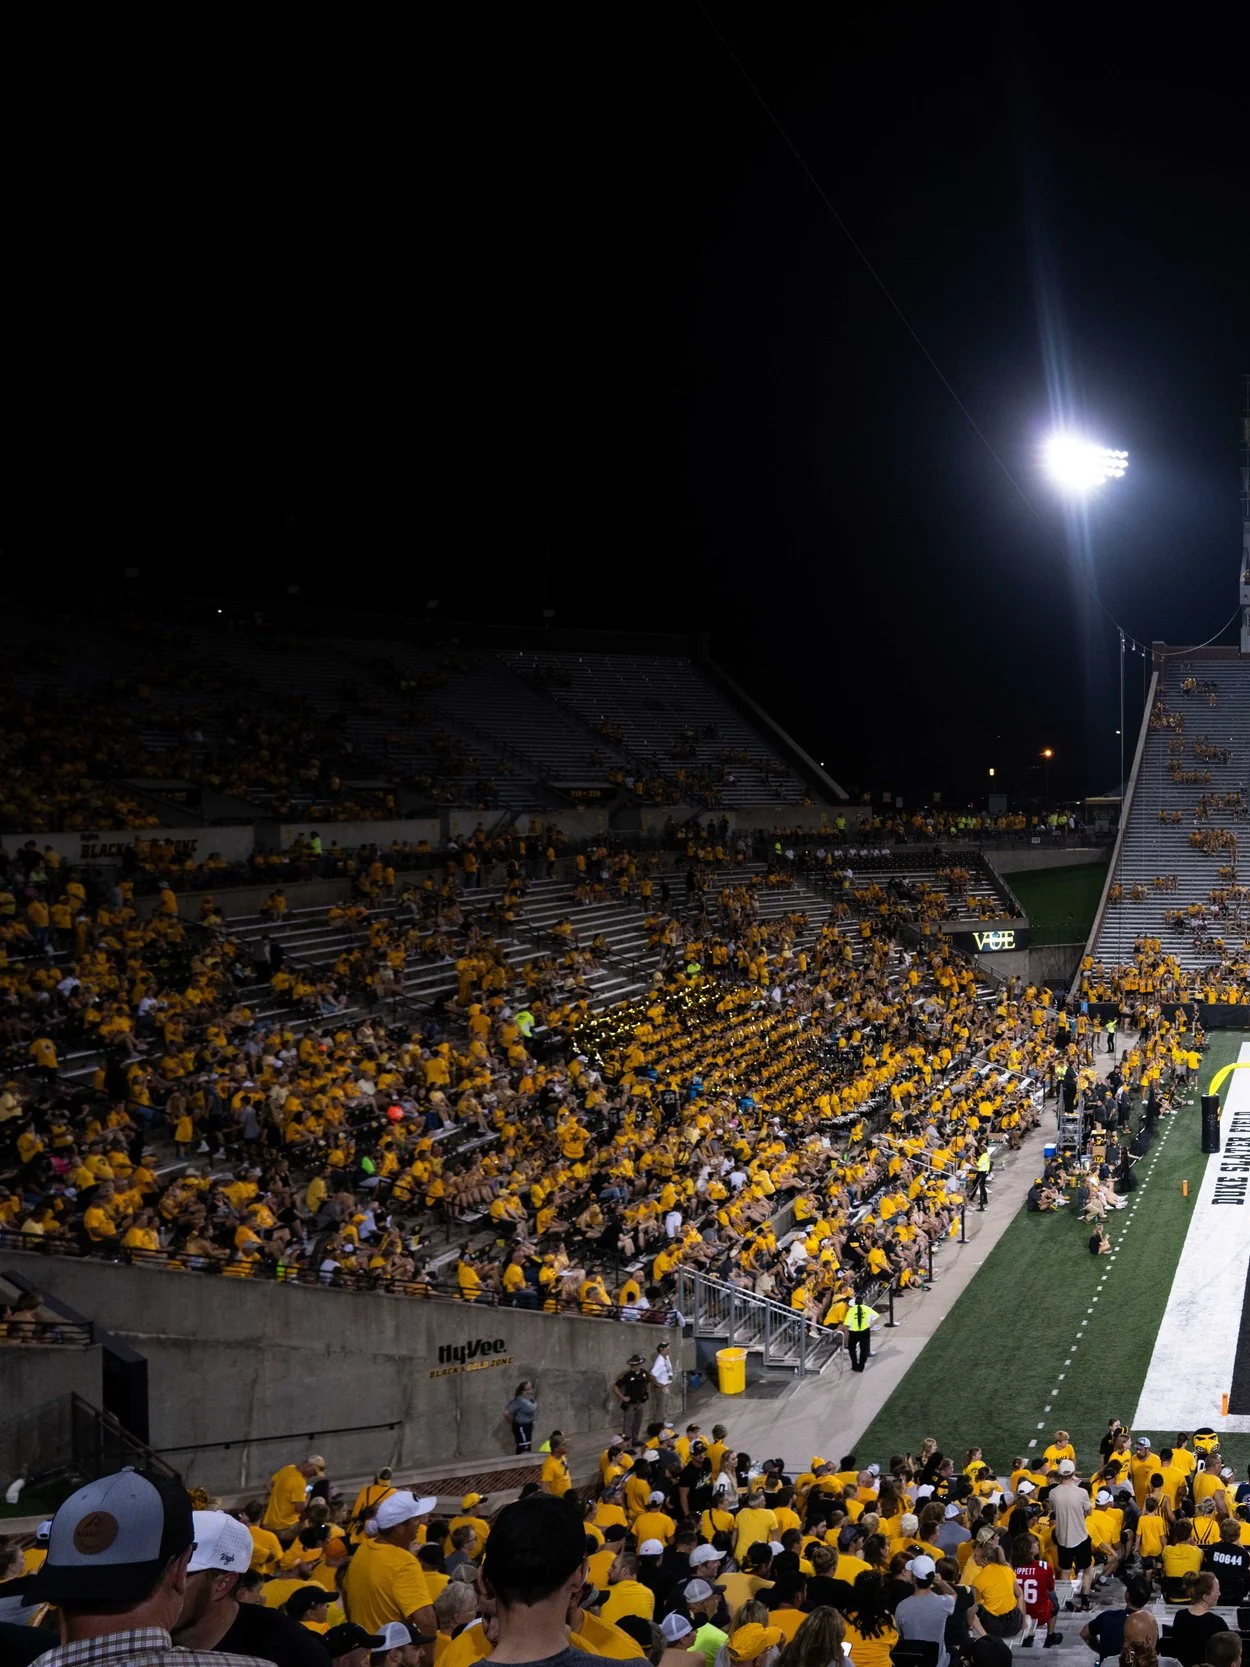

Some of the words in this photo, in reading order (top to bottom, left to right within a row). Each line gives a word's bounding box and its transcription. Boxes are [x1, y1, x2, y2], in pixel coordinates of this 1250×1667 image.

[972, 931, 1015, 950] VUE
[1211, 1177, 1248, 1205] DUKE
[1213, 1552, 1242, 1566] 50644
[1015, 1567, 1036, 1575] IPPETT
